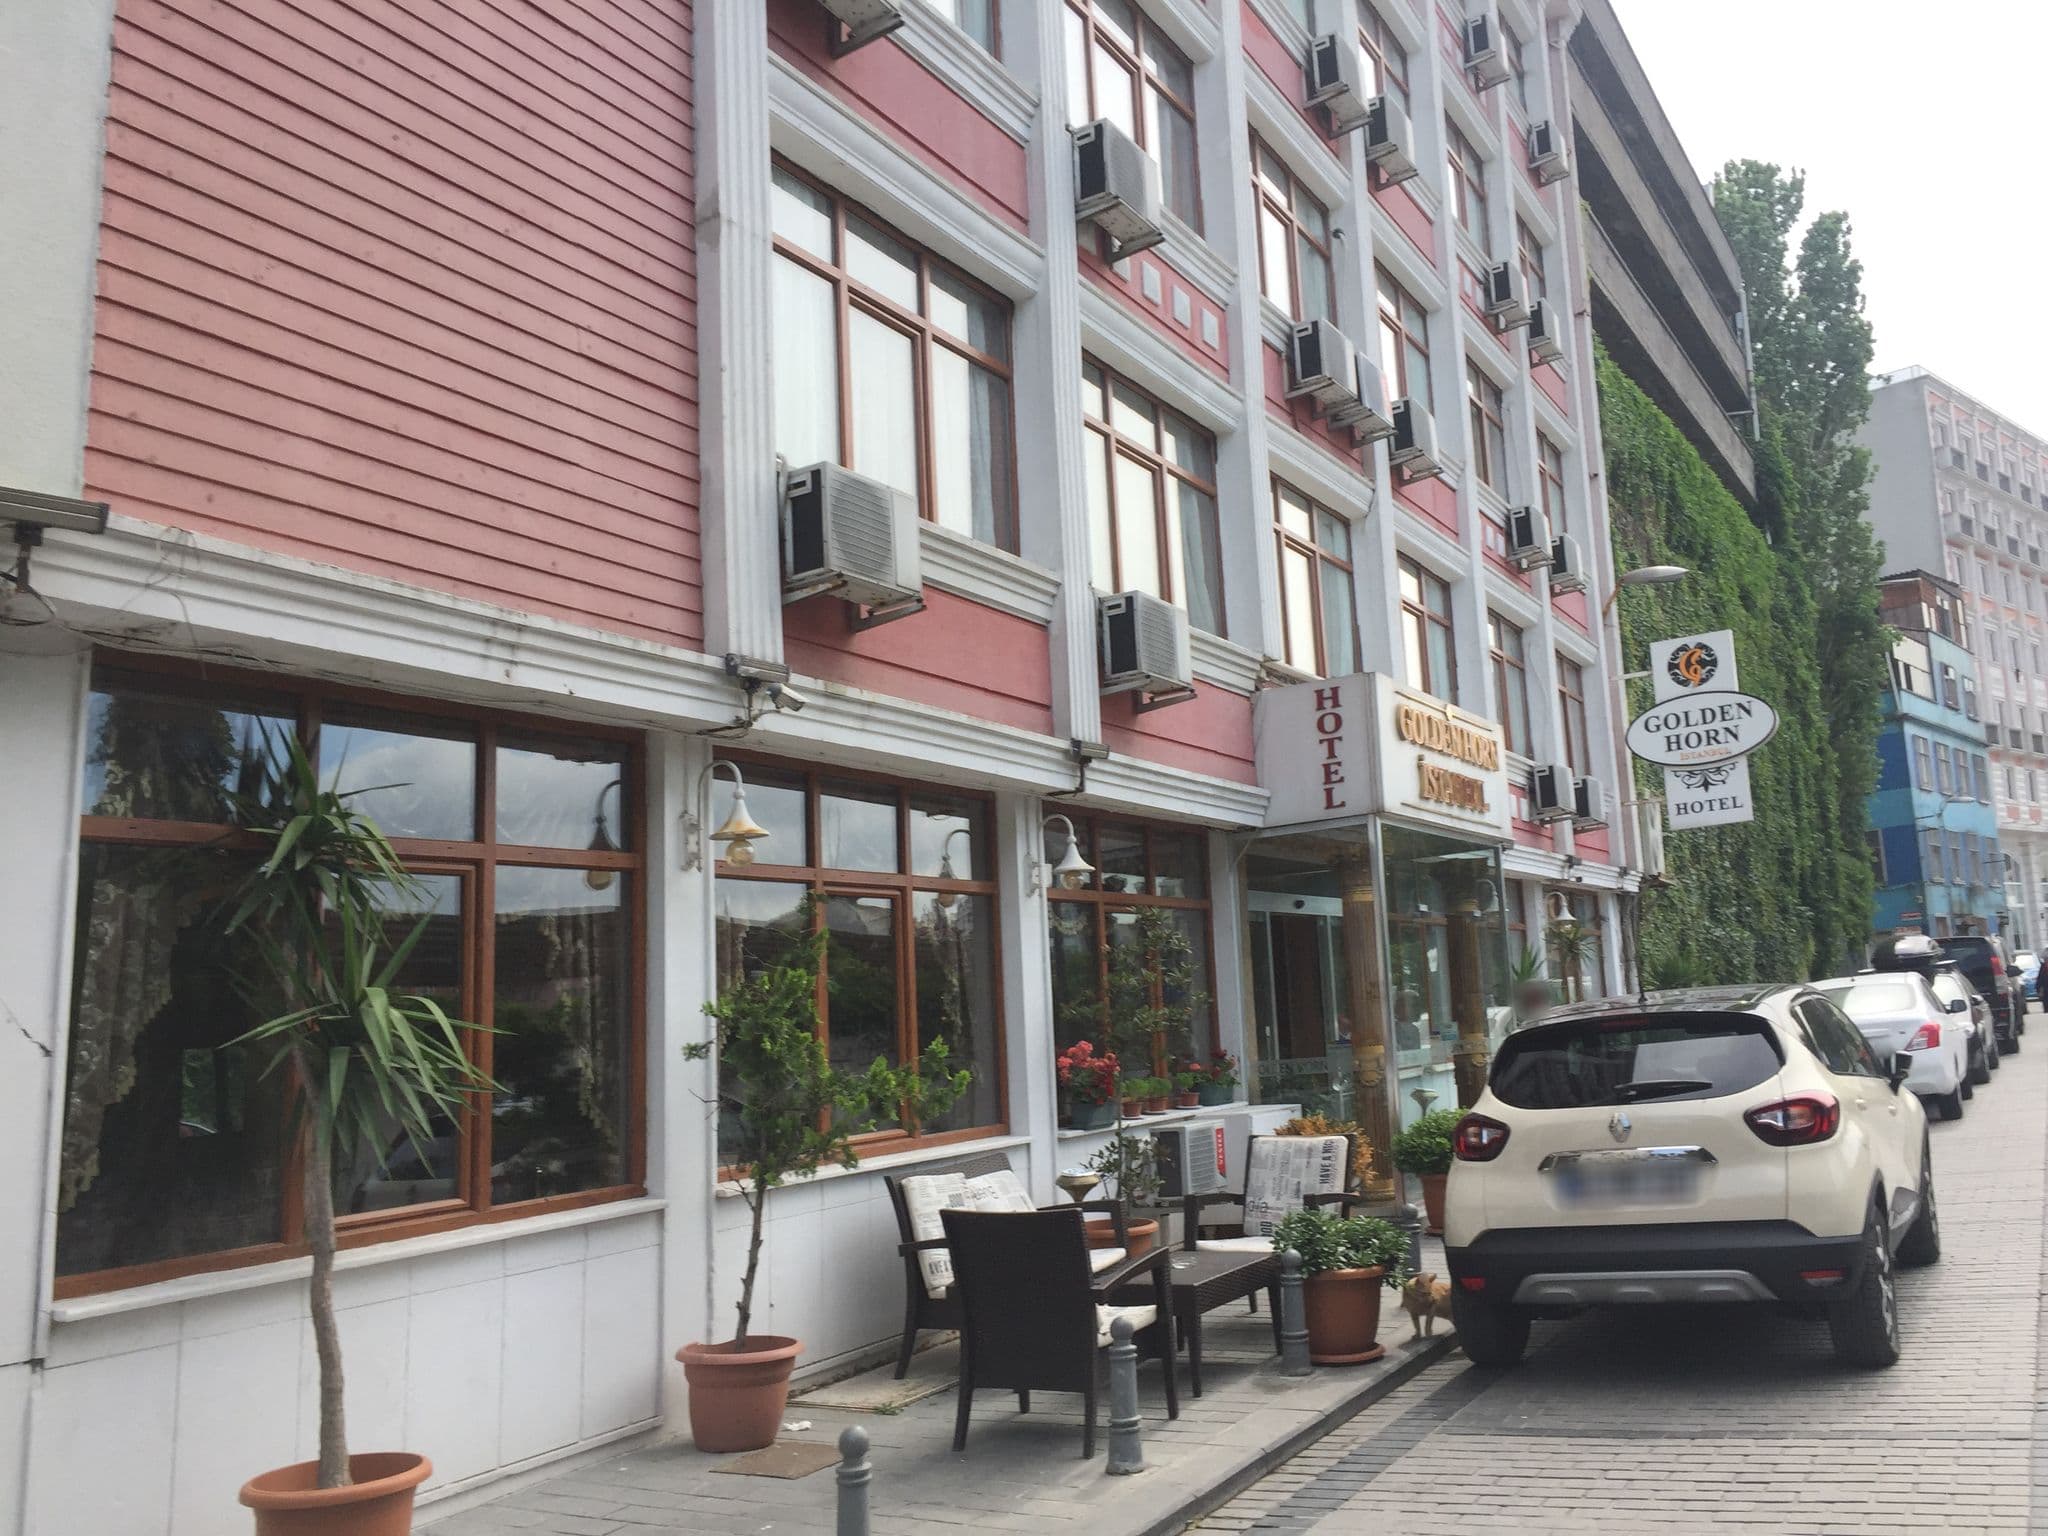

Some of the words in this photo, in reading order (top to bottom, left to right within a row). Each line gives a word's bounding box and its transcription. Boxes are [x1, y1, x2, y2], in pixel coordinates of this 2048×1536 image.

[1643, 700, 1754, 734] GOLDEN
[1314, 686, 1346, 810] HOTEL
[1397, 703, 1463, 760] GOLDEN
[1462, 726, 1499, 773] HORN
[1664, 724, 1741, 753] HORN
[1675, 795, 1744, 817] HOTEL
[1319, 1162, 1332, 1185] HAVE
